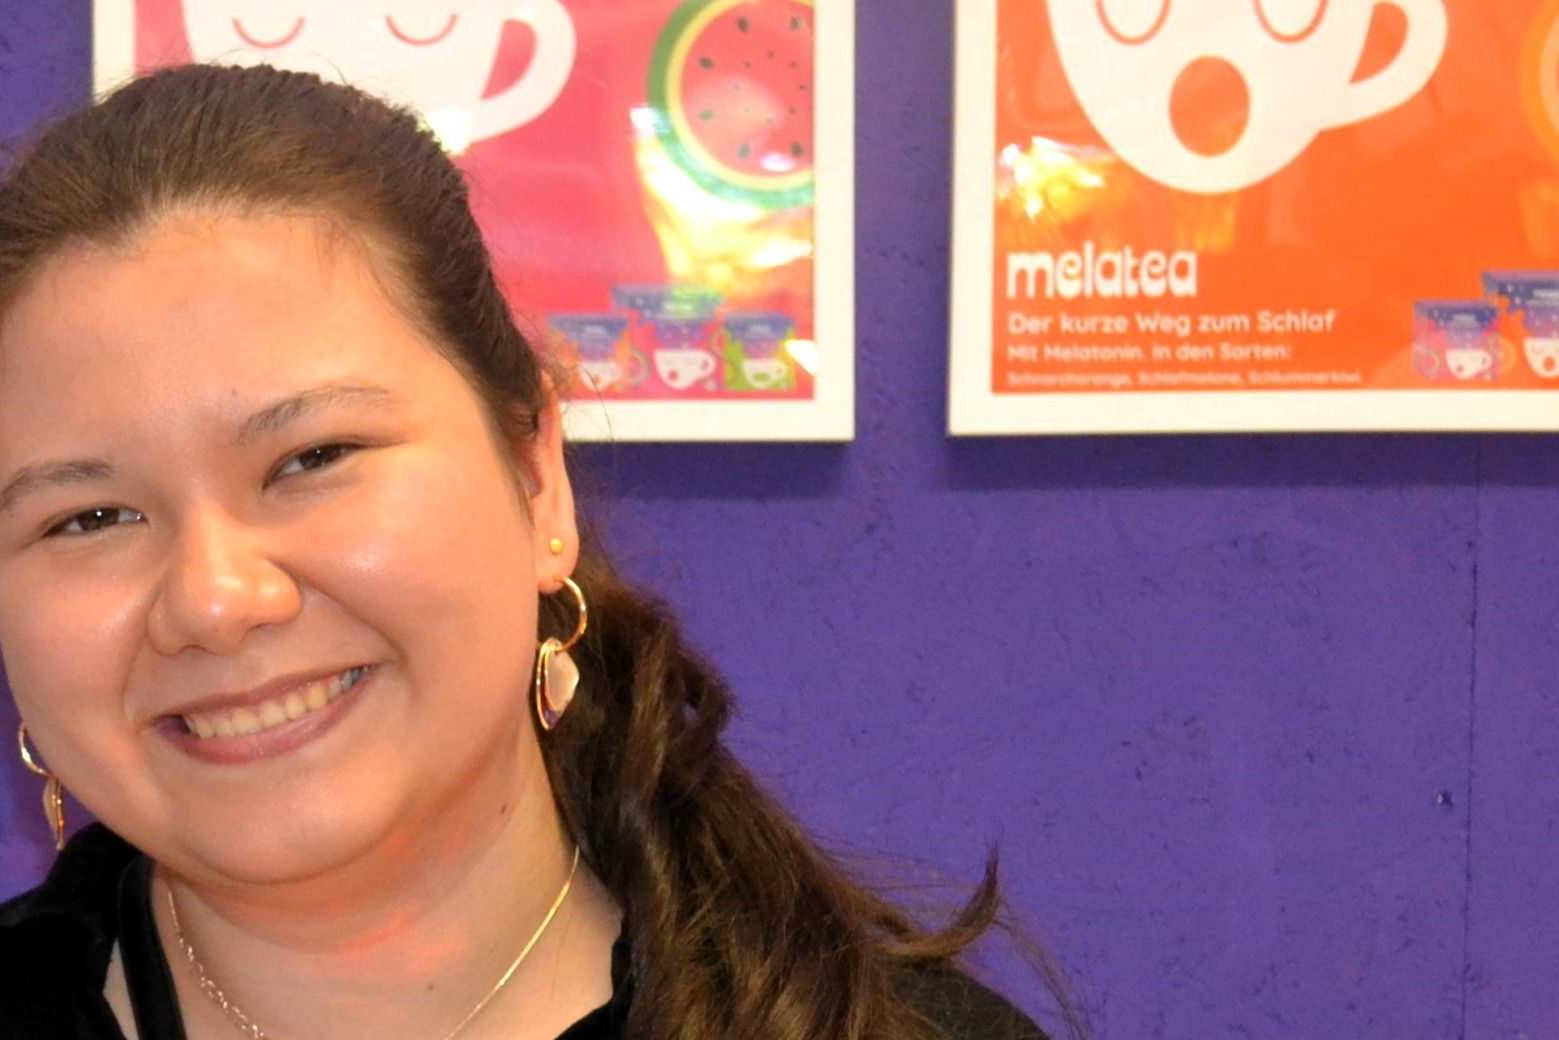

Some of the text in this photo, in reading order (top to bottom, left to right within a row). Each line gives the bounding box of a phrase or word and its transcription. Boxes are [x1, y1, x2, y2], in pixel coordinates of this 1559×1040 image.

[1007, 239, 1198, 300] melatea
[1008, 308, 1337, 338] Der kurze Weg zum Schlaf
[1007, 344, 1038, 362] Mit
[1176, 343, 1215, 361] den
[1219, 342, 1292, 361] Sorten:
